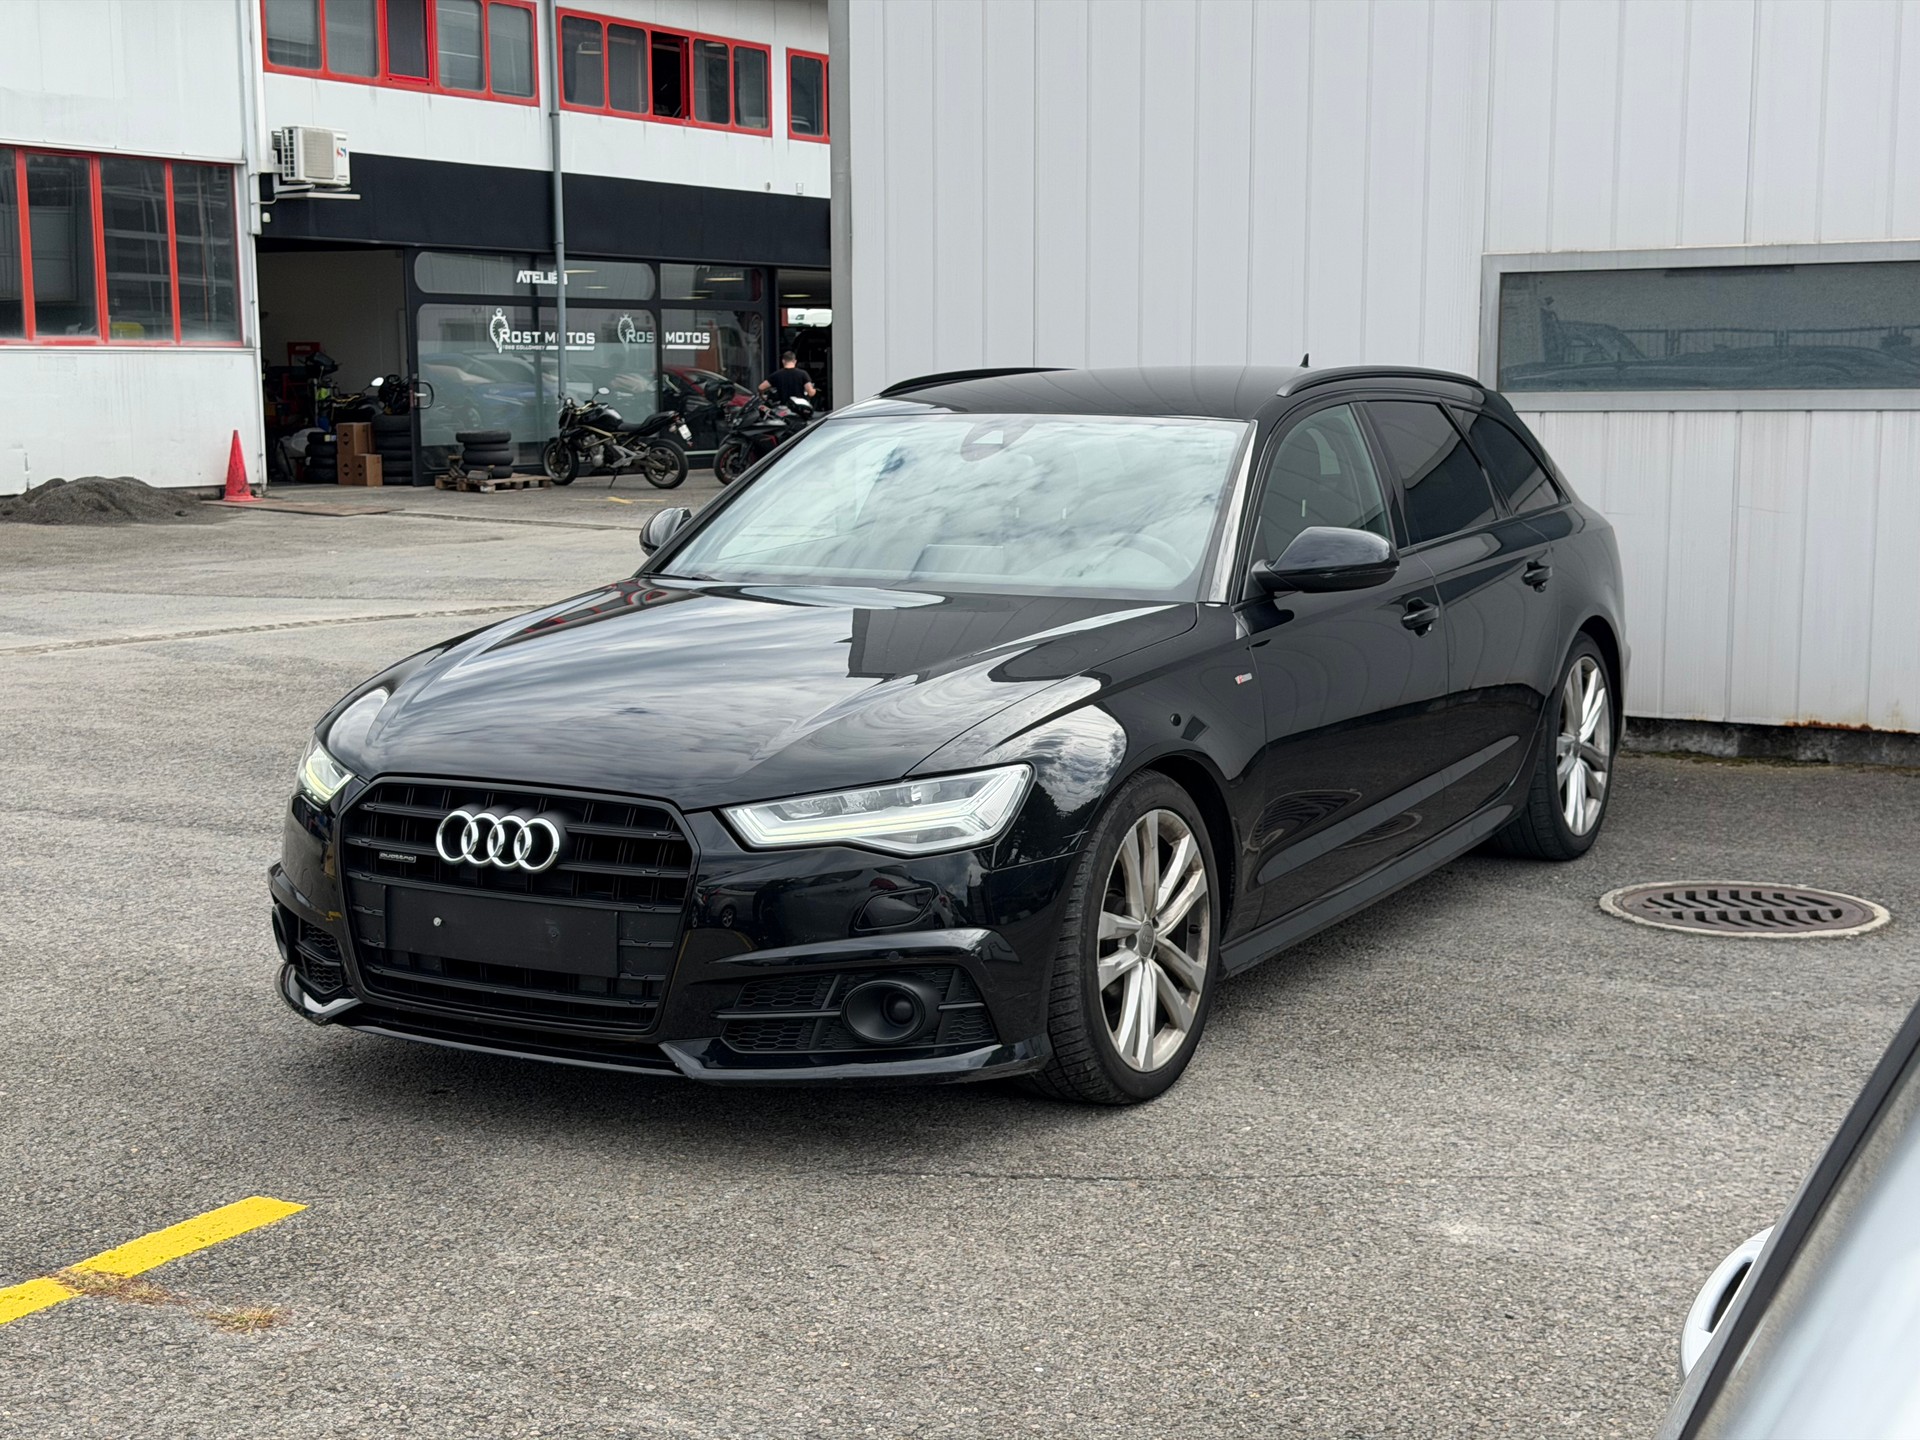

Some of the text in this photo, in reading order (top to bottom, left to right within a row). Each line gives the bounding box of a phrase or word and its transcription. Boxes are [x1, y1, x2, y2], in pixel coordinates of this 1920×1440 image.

[498, 328, 595, 344] ROST MTOS
[625, 329, 710, 344] ROS MOTOS
